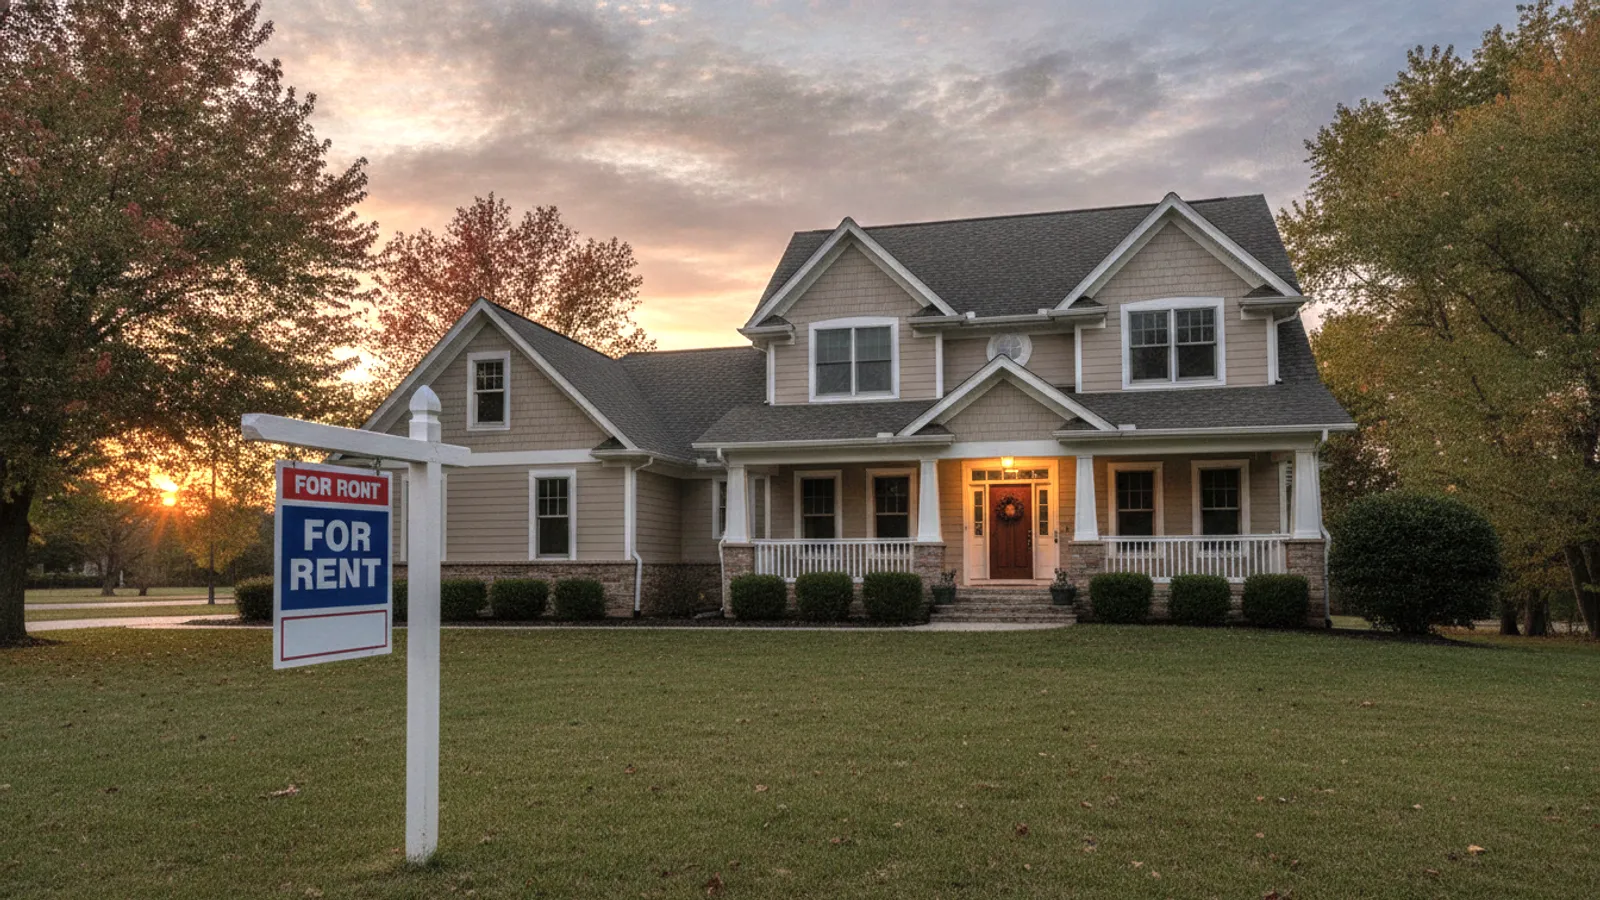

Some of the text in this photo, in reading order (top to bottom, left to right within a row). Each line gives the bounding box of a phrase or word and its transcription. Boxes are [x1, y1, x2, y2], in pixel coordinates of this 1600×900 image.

[295, 475, 381, 499] FOR RONT
[304, 519, 371, 552] FOR
[290, 558, 381, 591] RENT
